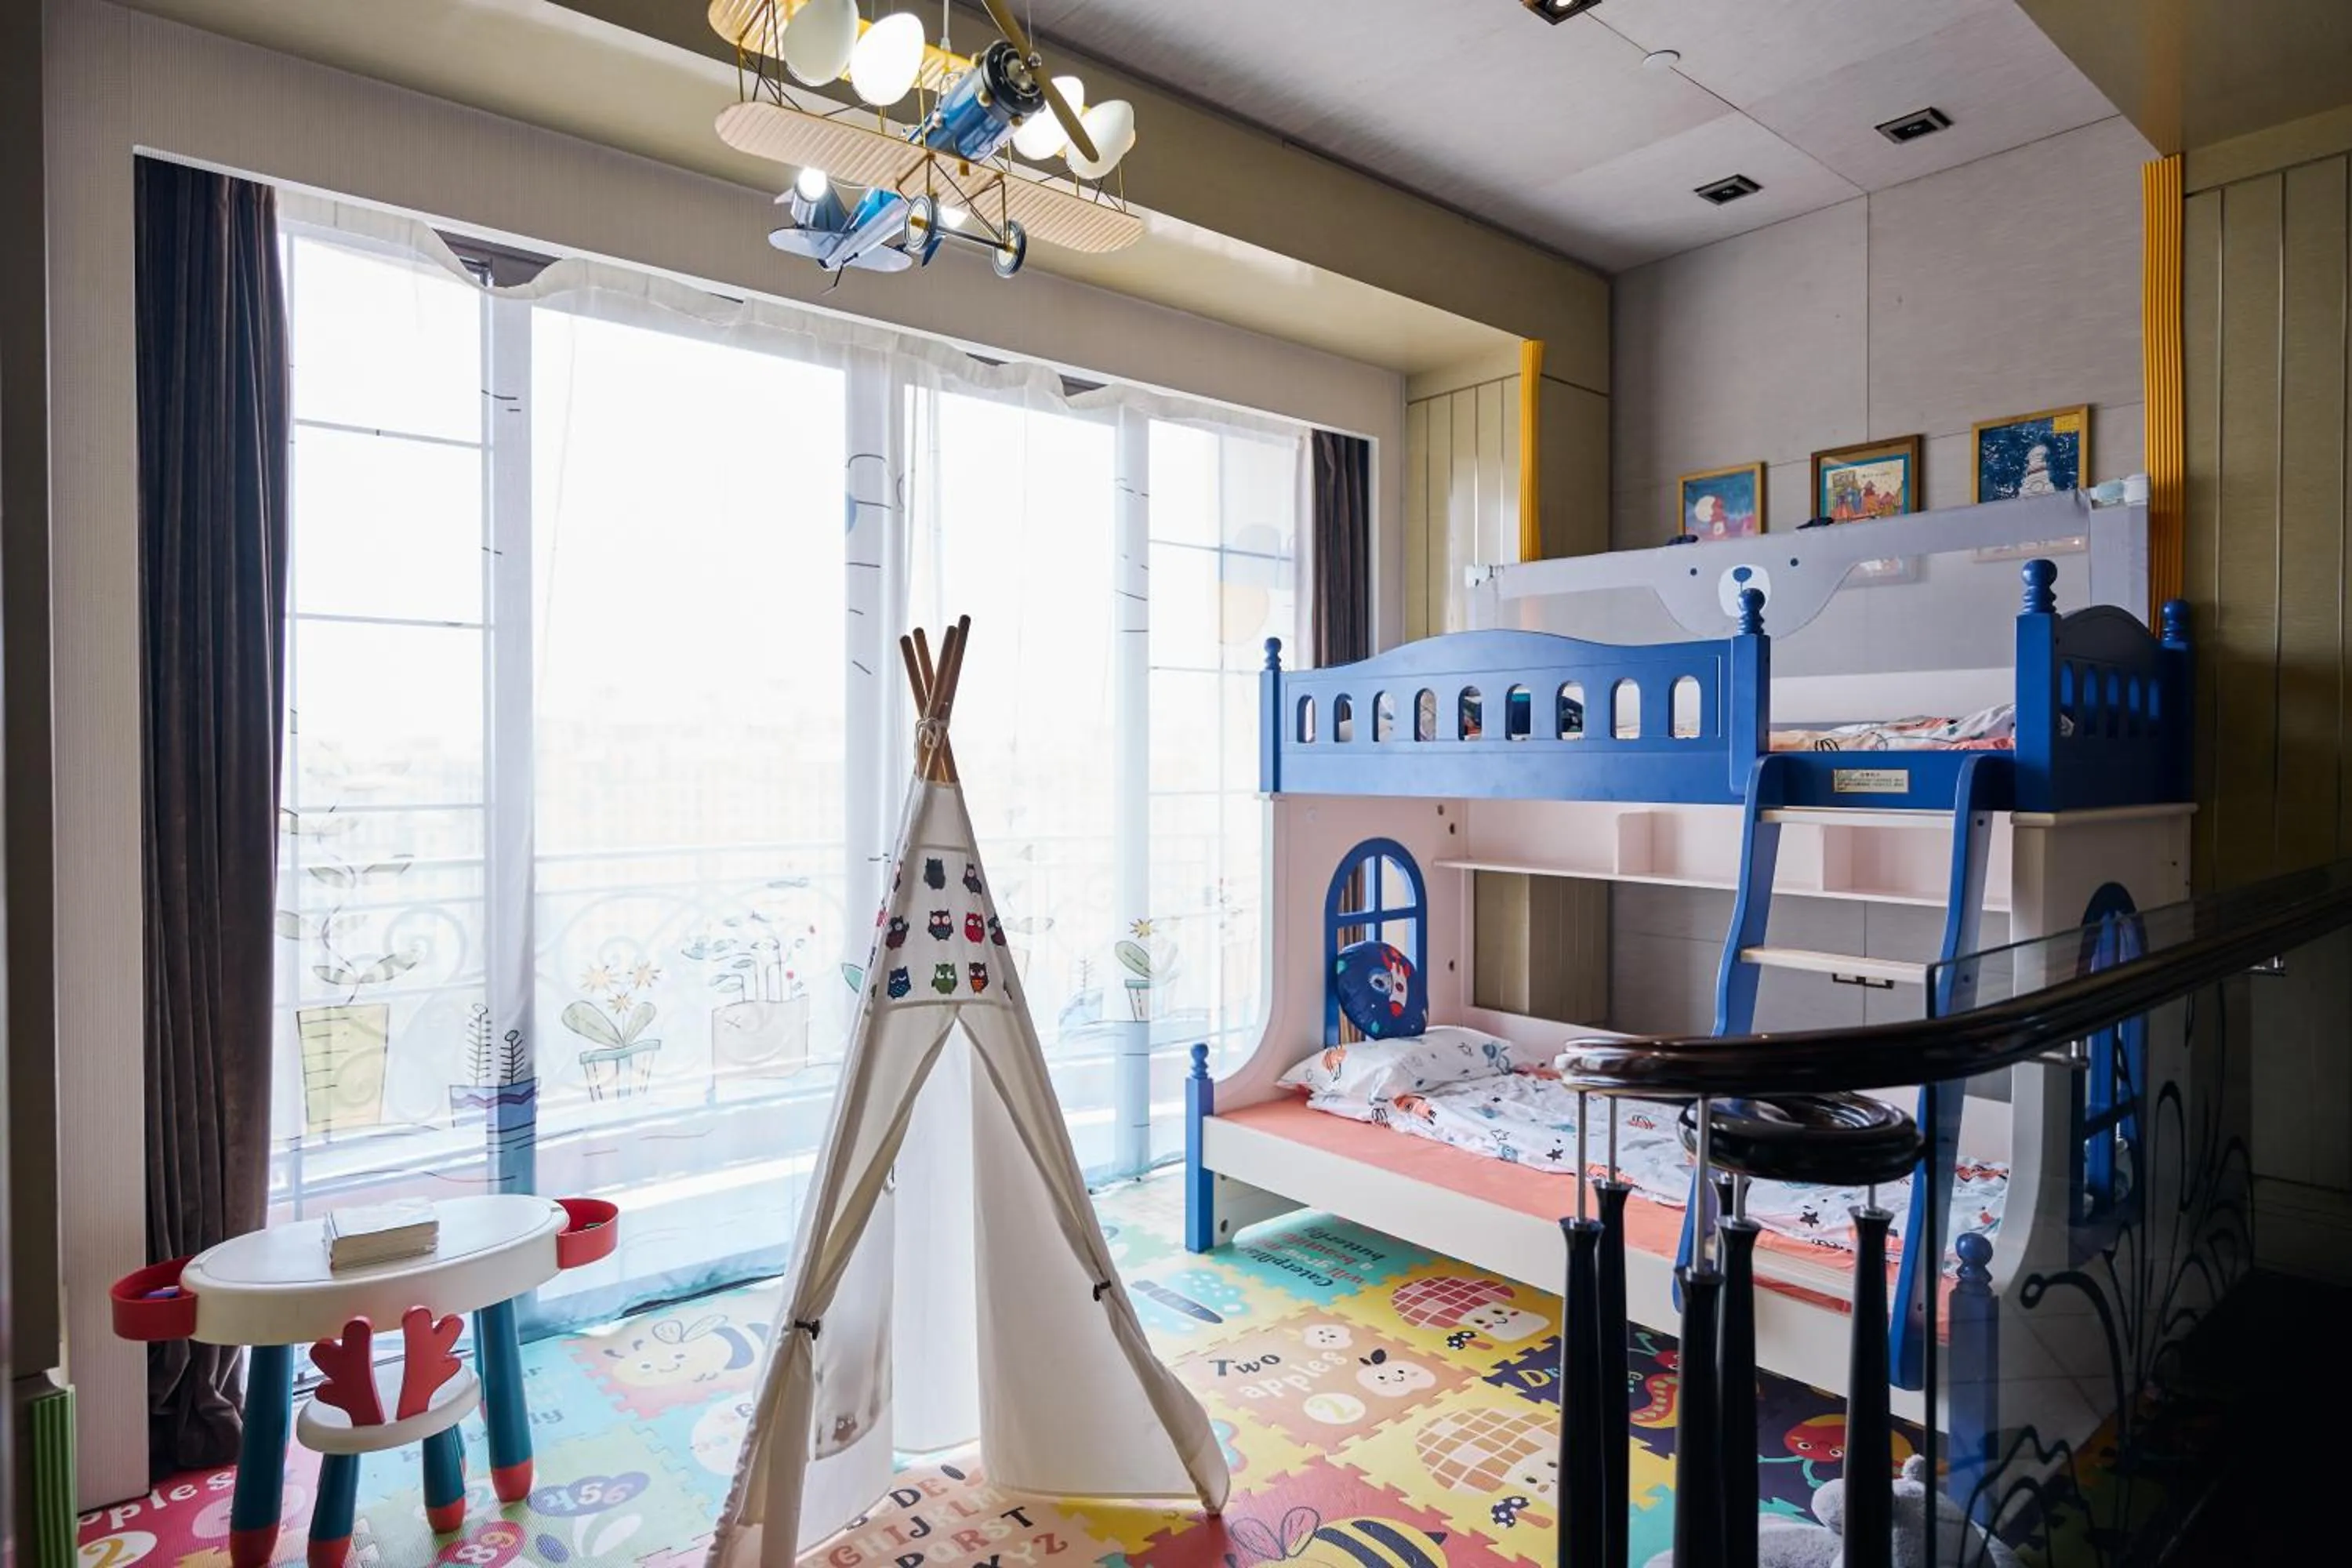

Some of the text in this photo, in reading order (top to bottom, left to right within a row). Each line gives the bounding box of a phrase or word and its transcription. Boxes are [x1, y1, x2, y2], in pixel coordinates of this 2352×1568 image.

[1207, 1354, 1281, 1377] Two
[1237, 1351, 1348, 1399] apples
[76, 1471, 234, 1534] pples
